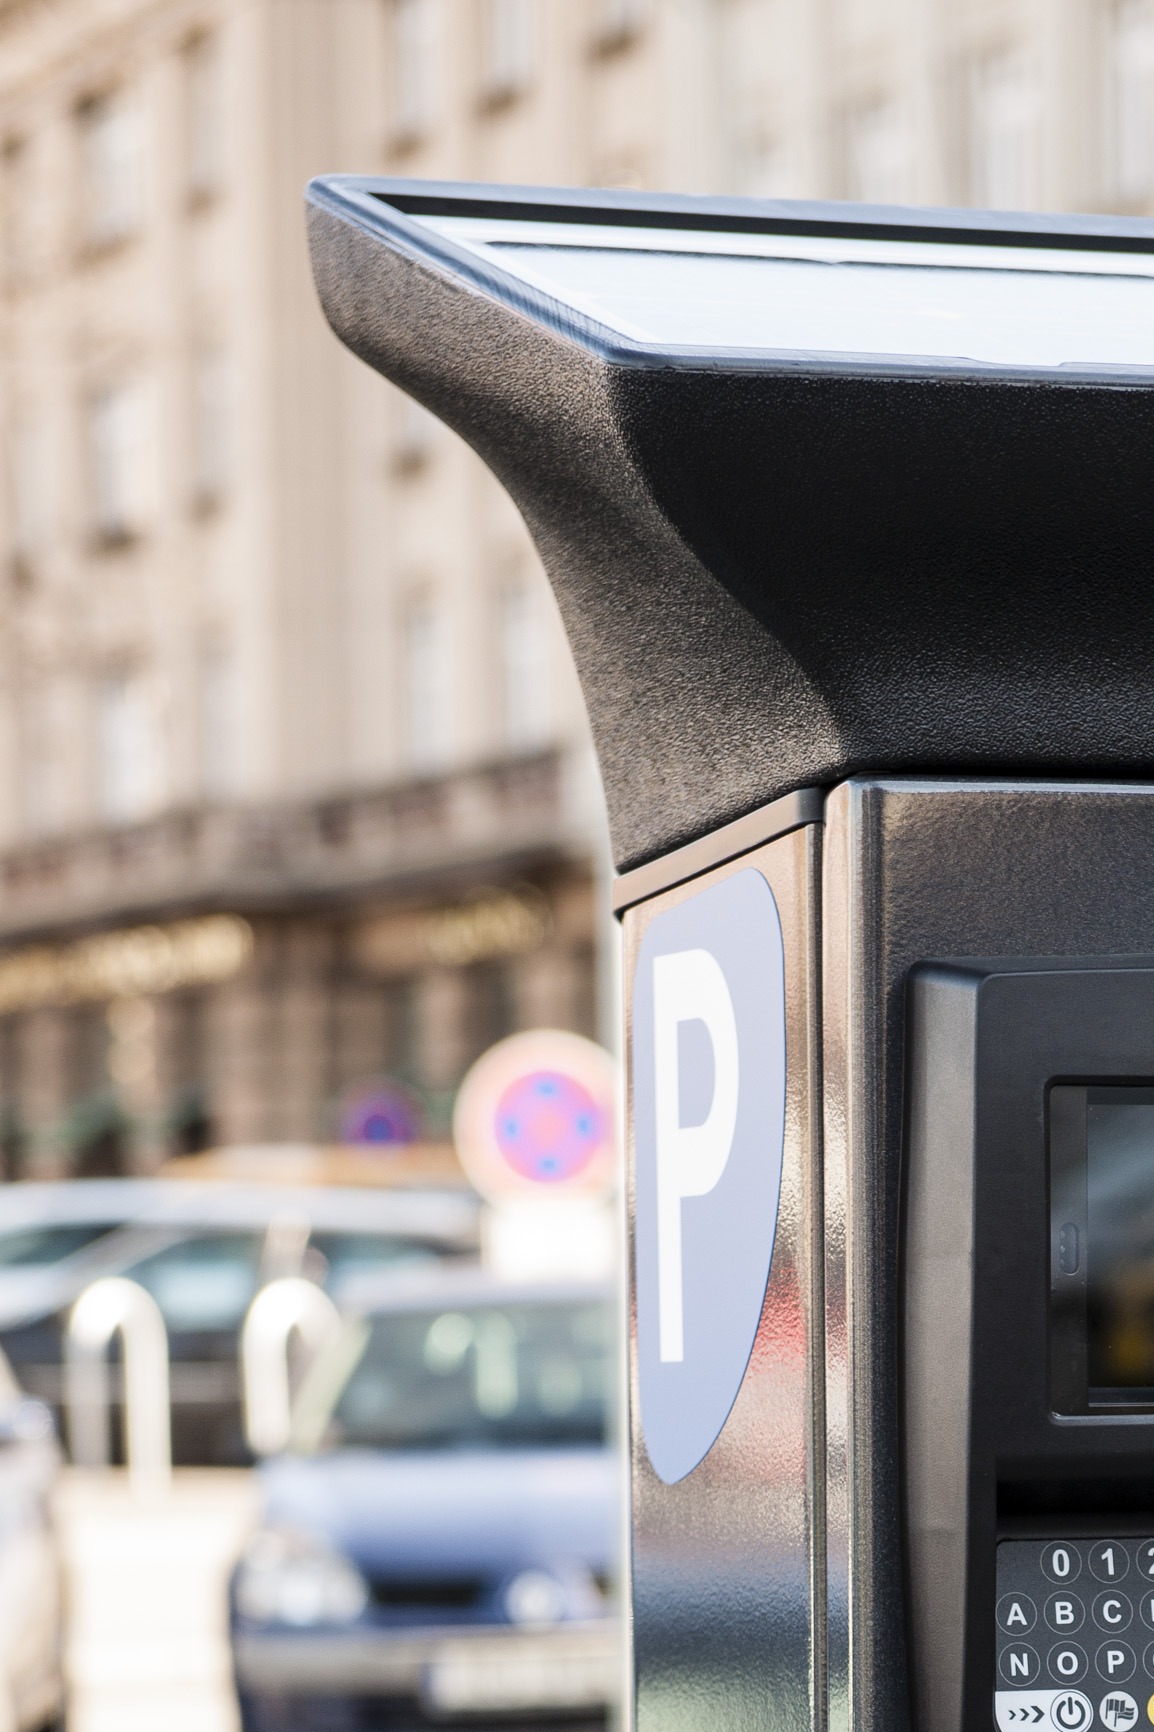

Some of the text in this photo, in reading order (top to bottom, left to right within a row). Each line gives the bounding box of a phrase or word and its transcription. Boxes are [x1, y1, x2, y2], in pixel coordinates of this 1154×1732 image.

[653, 948, 740, 1362] P
[1052, 1549, 1070, 1577] 0
[1101, 1548, 1115, 1576] 1
[1006, 1602, 1028, 1626] A
[1054, 1601, 1075, 1625] B
[1102, 1599, 1122, 1624] C
[1010, 1652, 1029, 1677] N
[1056, 1651, 1079, 1675] O
[1107, 1650, 1125, 1674] P
